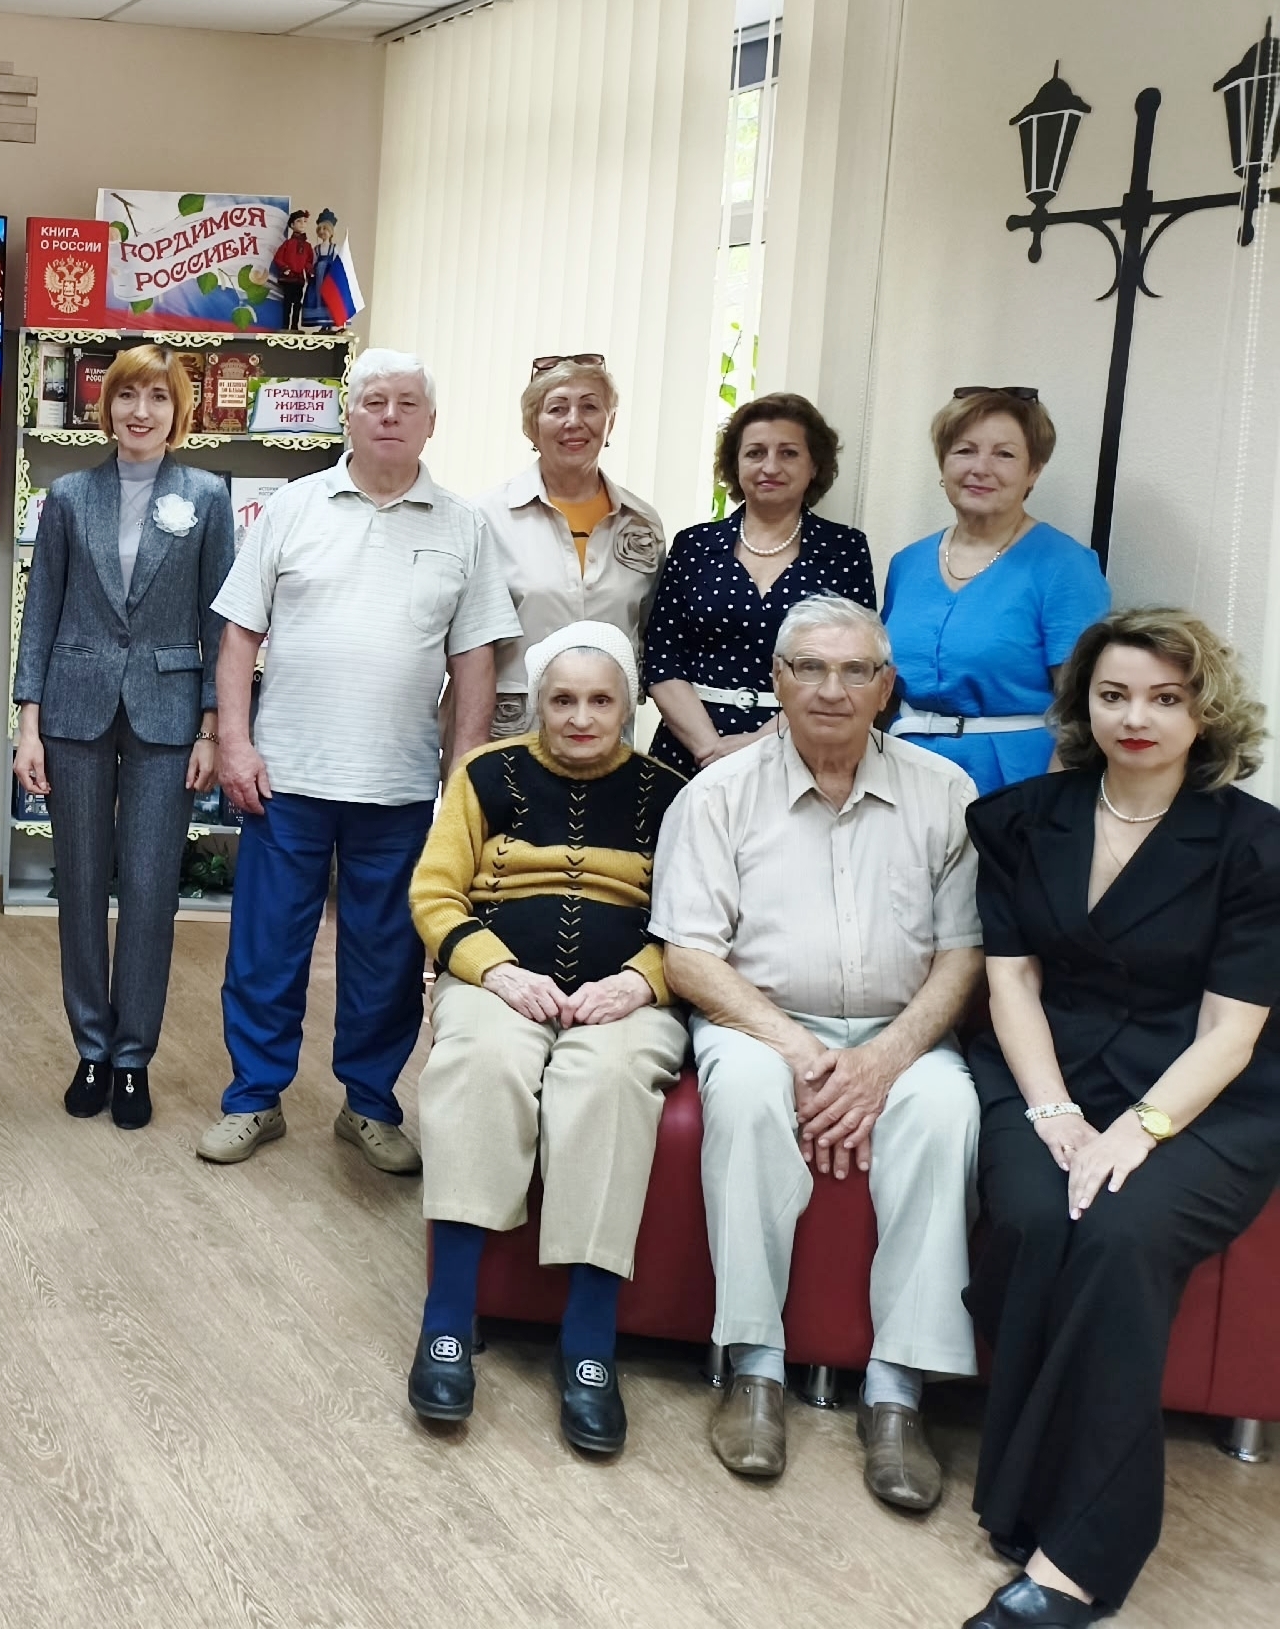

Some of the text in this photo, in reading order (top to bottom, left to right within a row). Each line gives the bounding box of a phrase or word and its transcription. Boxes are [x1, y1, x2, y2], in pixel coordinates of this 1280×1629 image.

[41, 226, 80, 238] КНИГА
[120, 207, 267, 262] ГОРДИМСЯ
[40, 240, 102, 252] О РОССИИ
[135, 232, 259, 291] РОССИЕЙ
[264, 388, 333, 399] ТРАДИЦИИ
[275, 401, 325, 411] ЖИВАЯ
[279, 414, 315, 423] НИТЬ
